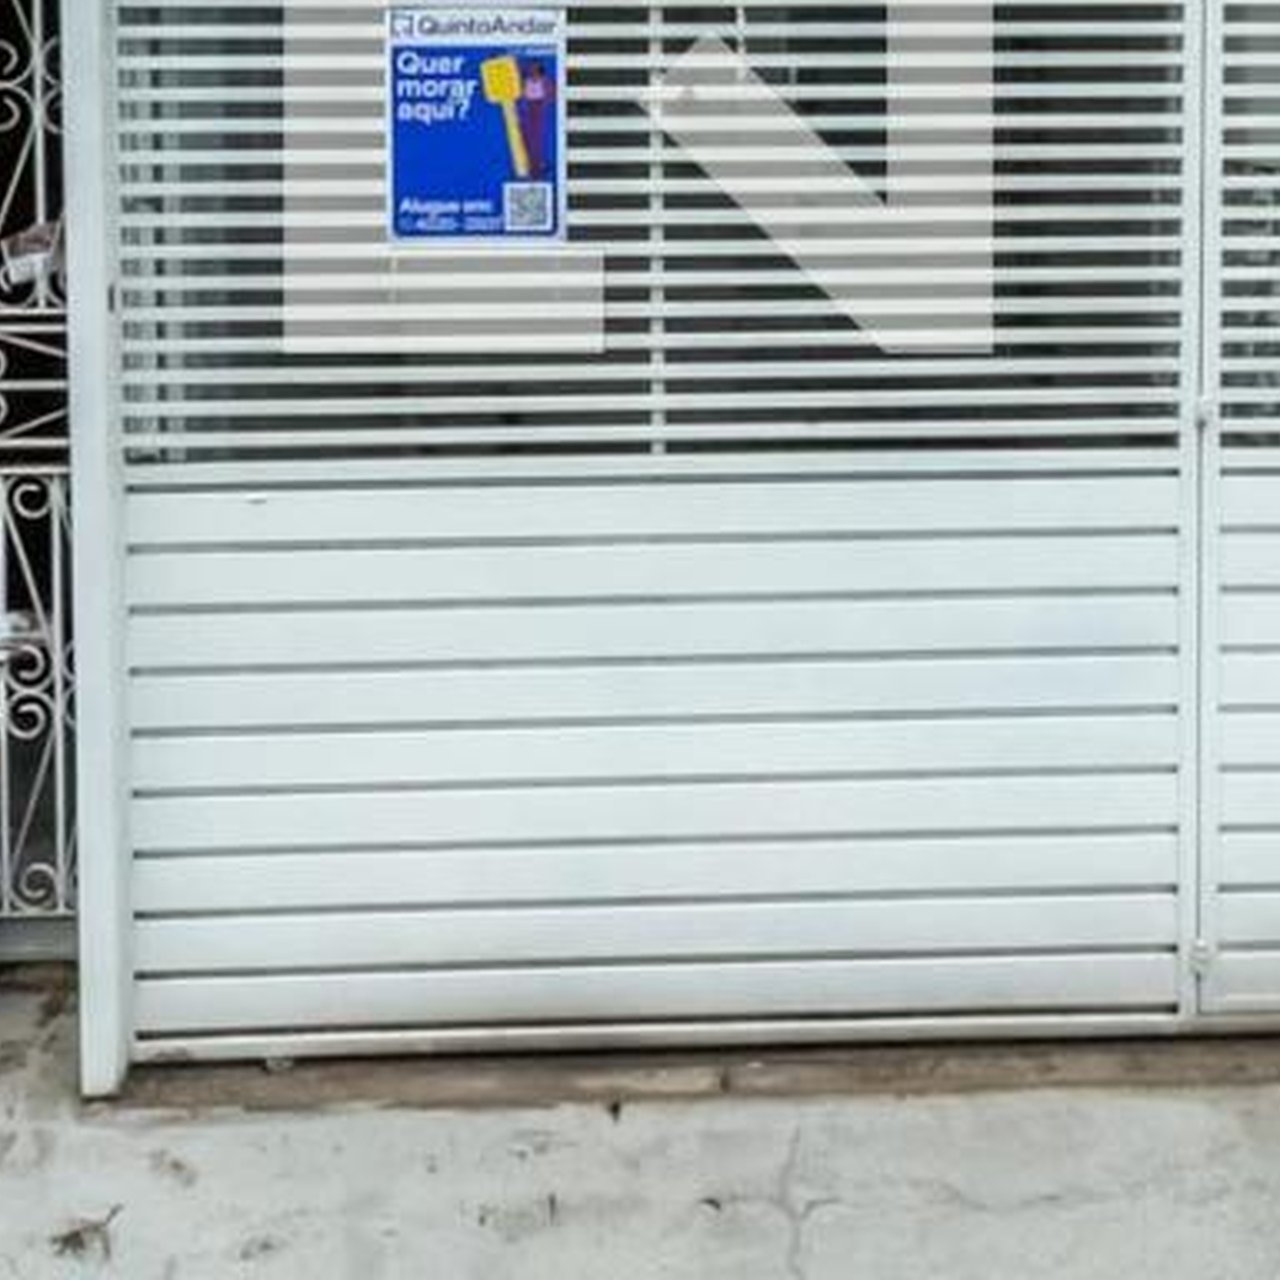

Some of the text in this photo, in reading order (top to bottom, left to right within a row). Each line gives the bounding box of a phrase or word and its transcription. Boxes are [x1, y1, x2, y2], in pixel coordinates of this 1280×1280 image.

[417, 15, 557, 36] QuintoAndar
[397, 51, 464, 74] Quer
[397, 79, 477, 96] morar
[397, 100, 470, 125] aqui?
